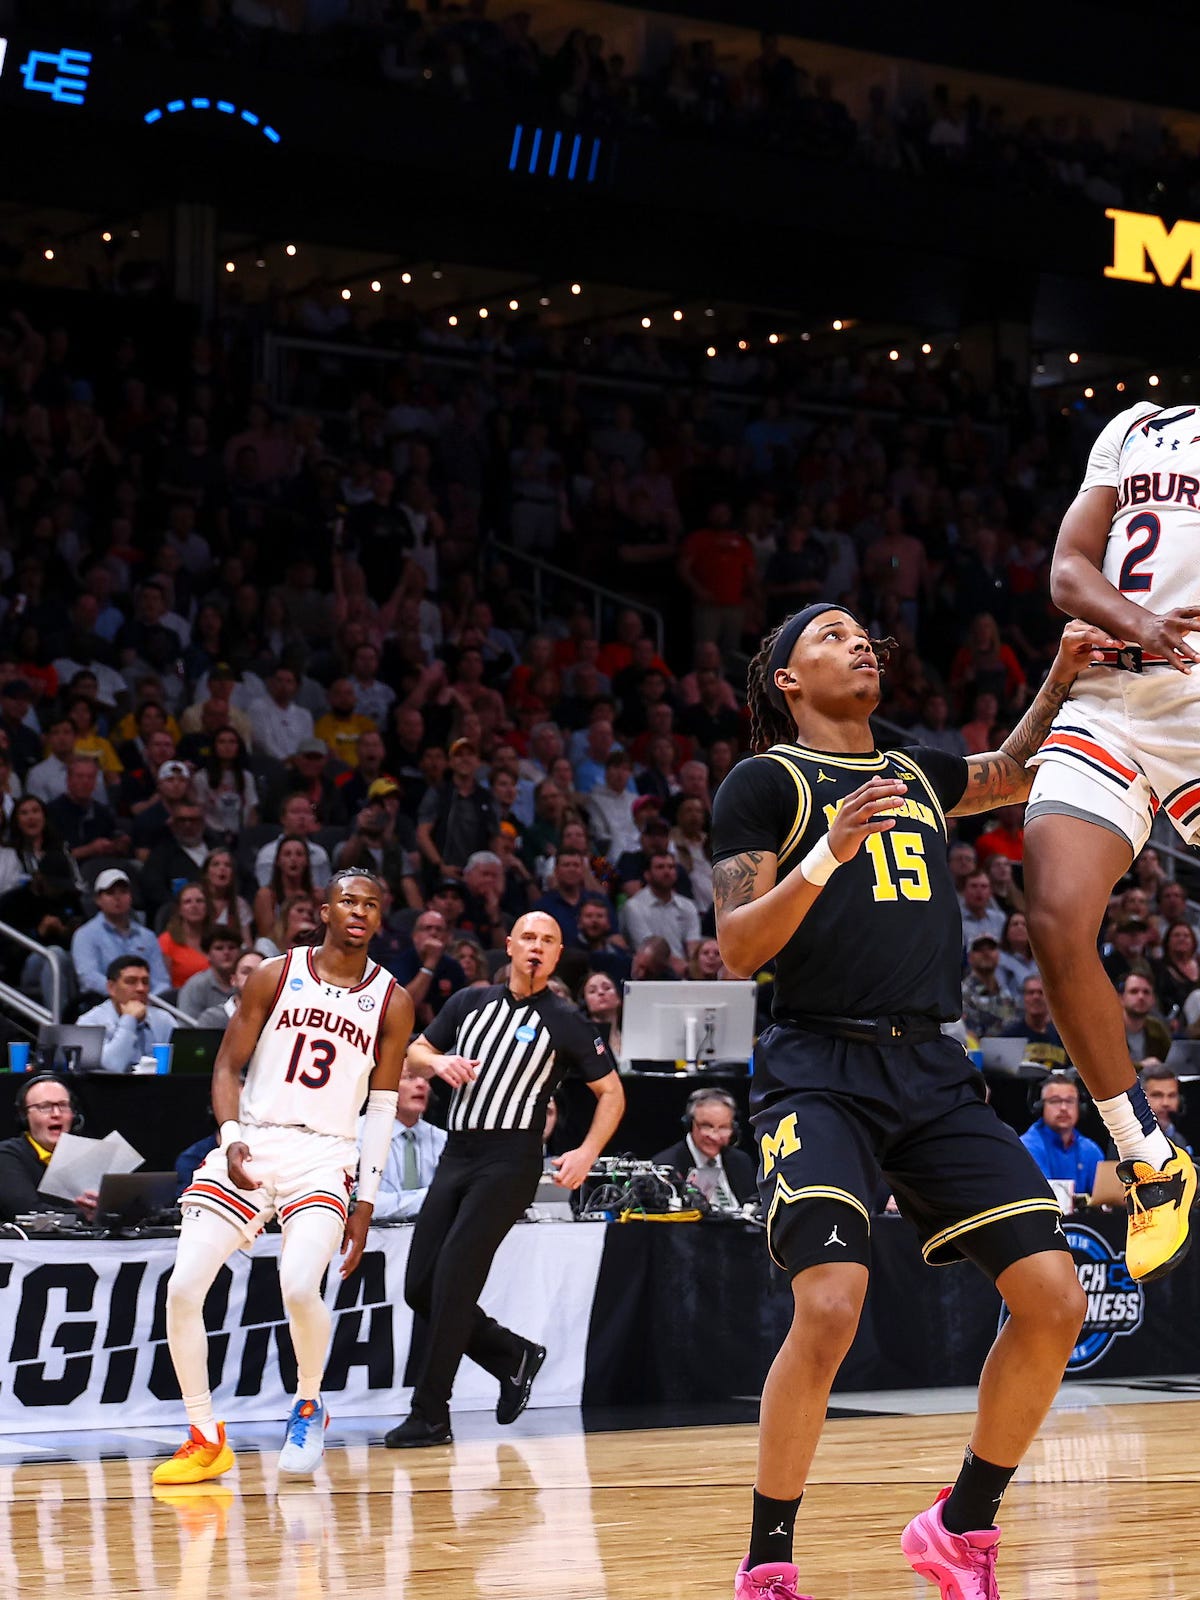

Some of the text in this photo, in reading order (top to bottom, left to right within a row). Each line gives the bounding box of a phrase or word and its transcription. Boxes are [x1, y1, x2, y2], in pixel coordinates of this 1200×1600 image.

[1118, 511, 1161, 593] 2
[865, 830, 933, 902] 15
[275, 1007, 372, 1056] AUBURN
[284, 1032, 337, 1089] 13
[760, 1111, 802, 1180] M
[1084, 1292, 1140, 1322] NESS
